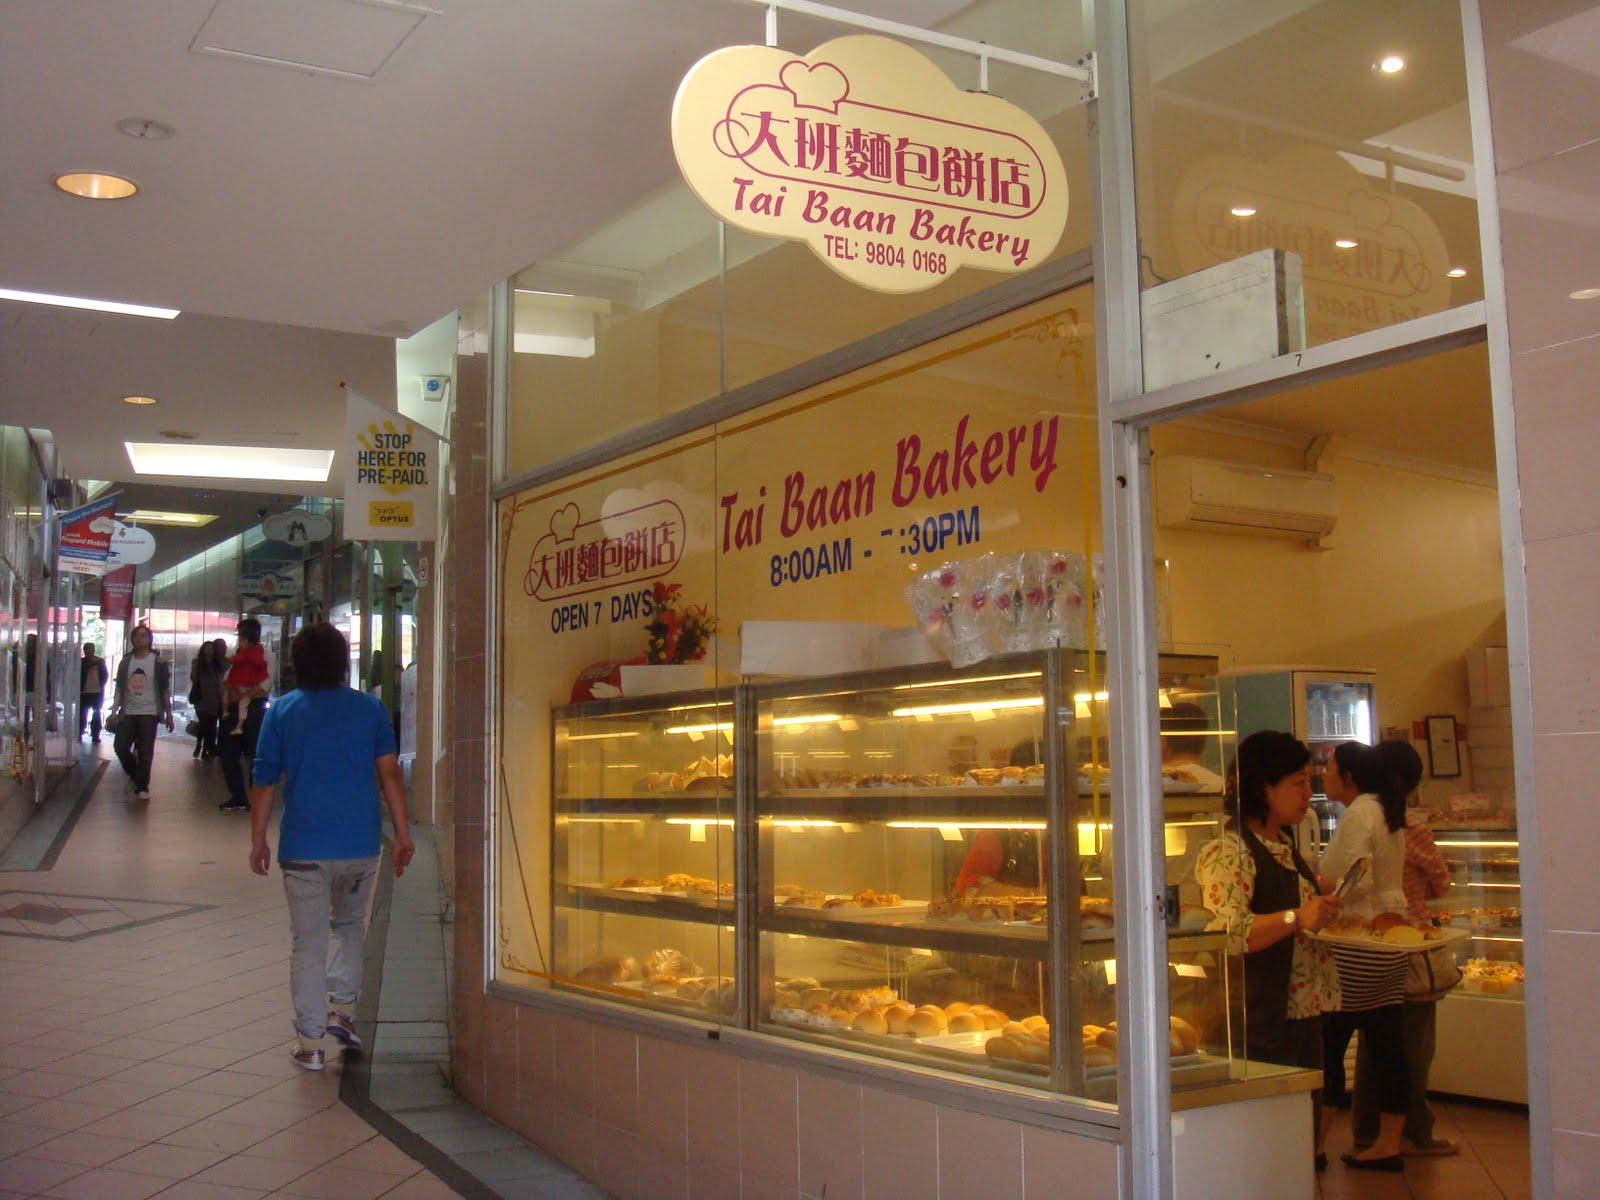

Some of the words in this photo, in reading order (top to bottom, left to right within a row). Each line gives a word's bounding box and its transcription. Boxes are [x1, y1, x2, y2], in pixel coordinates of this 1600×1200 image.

[739, 110, 1032, 209] 大班麵包餅店
[732, 177, 786, 217] Tai
[802, 189, 897, 235] Baan
[909, 208, 1031, 267] Bakery
[824, 234, 860, 261] TEL:
[866, 241, 906, 269] 9804
[913, 248, 948, 276] 0168
[358, 451, 395, 467] HERE
[398, 452, 426, 467] FOR
[374, 433, 411, 449] STOP
[358, 469, 429, 485] PRE-PAID.
[720, 485, 767, 555] Tai
[779, 470, 876, 538] Baan
[891, 414, 1059, 508] Bakery
[380, 515, 409, 523] OPTUS
[61, 535, 86, 545] Prepaid
[87, 538, 110, 547] Mobile
[535, 520, 676, 591] 大班麵包餅店
[770, 537, 852, 587] 8:00AM
[551, 601, 589, 634] OPEN
[594, 602, 602, 625] 7
[611, 589, 653, 623] DAYS
